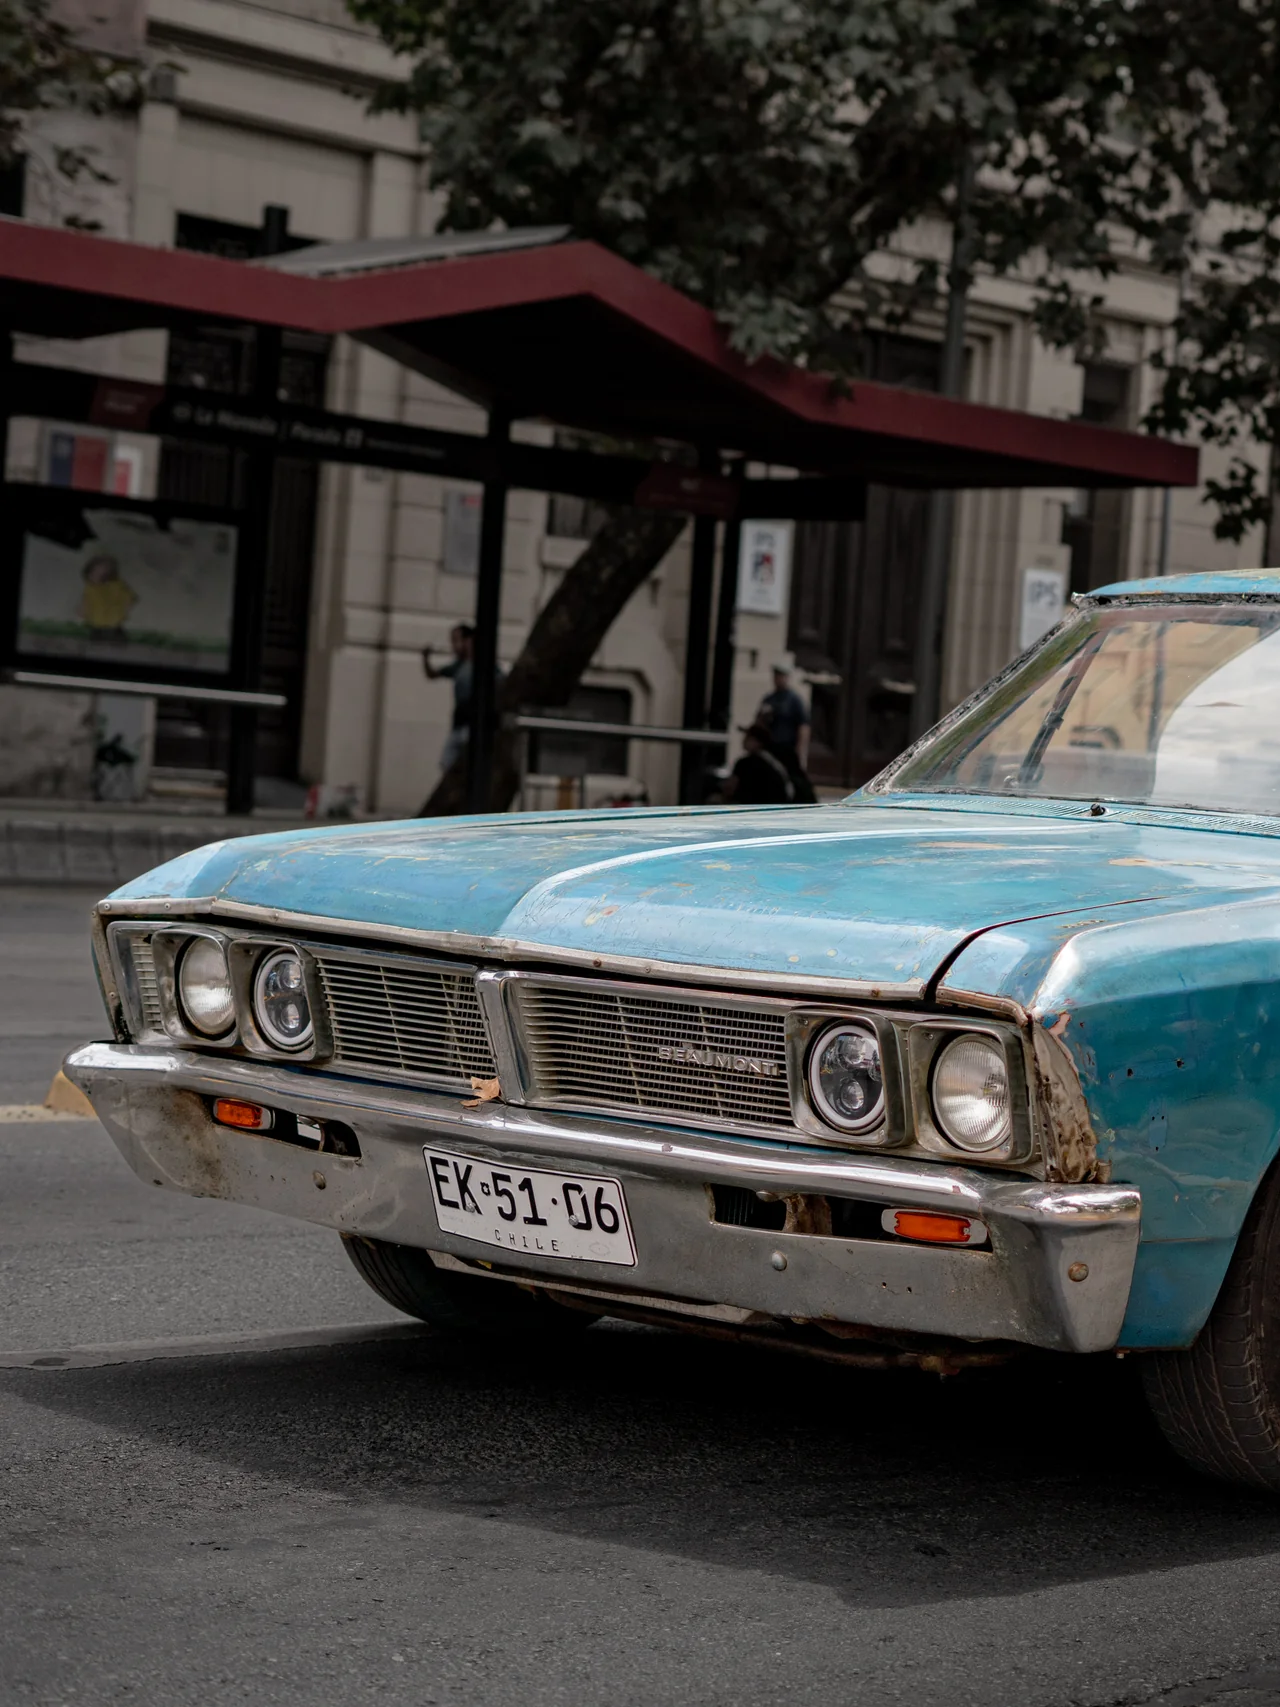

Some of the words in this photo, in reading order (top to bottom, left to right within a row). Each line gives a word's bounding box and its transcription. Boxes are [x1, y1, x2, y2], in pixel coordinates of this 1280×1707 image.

[1028, 580, 1058, 606] IPS
[658, 1046, 778, 1075] BEAUMONT
[494, 1228, 560, 1252] CHILE
